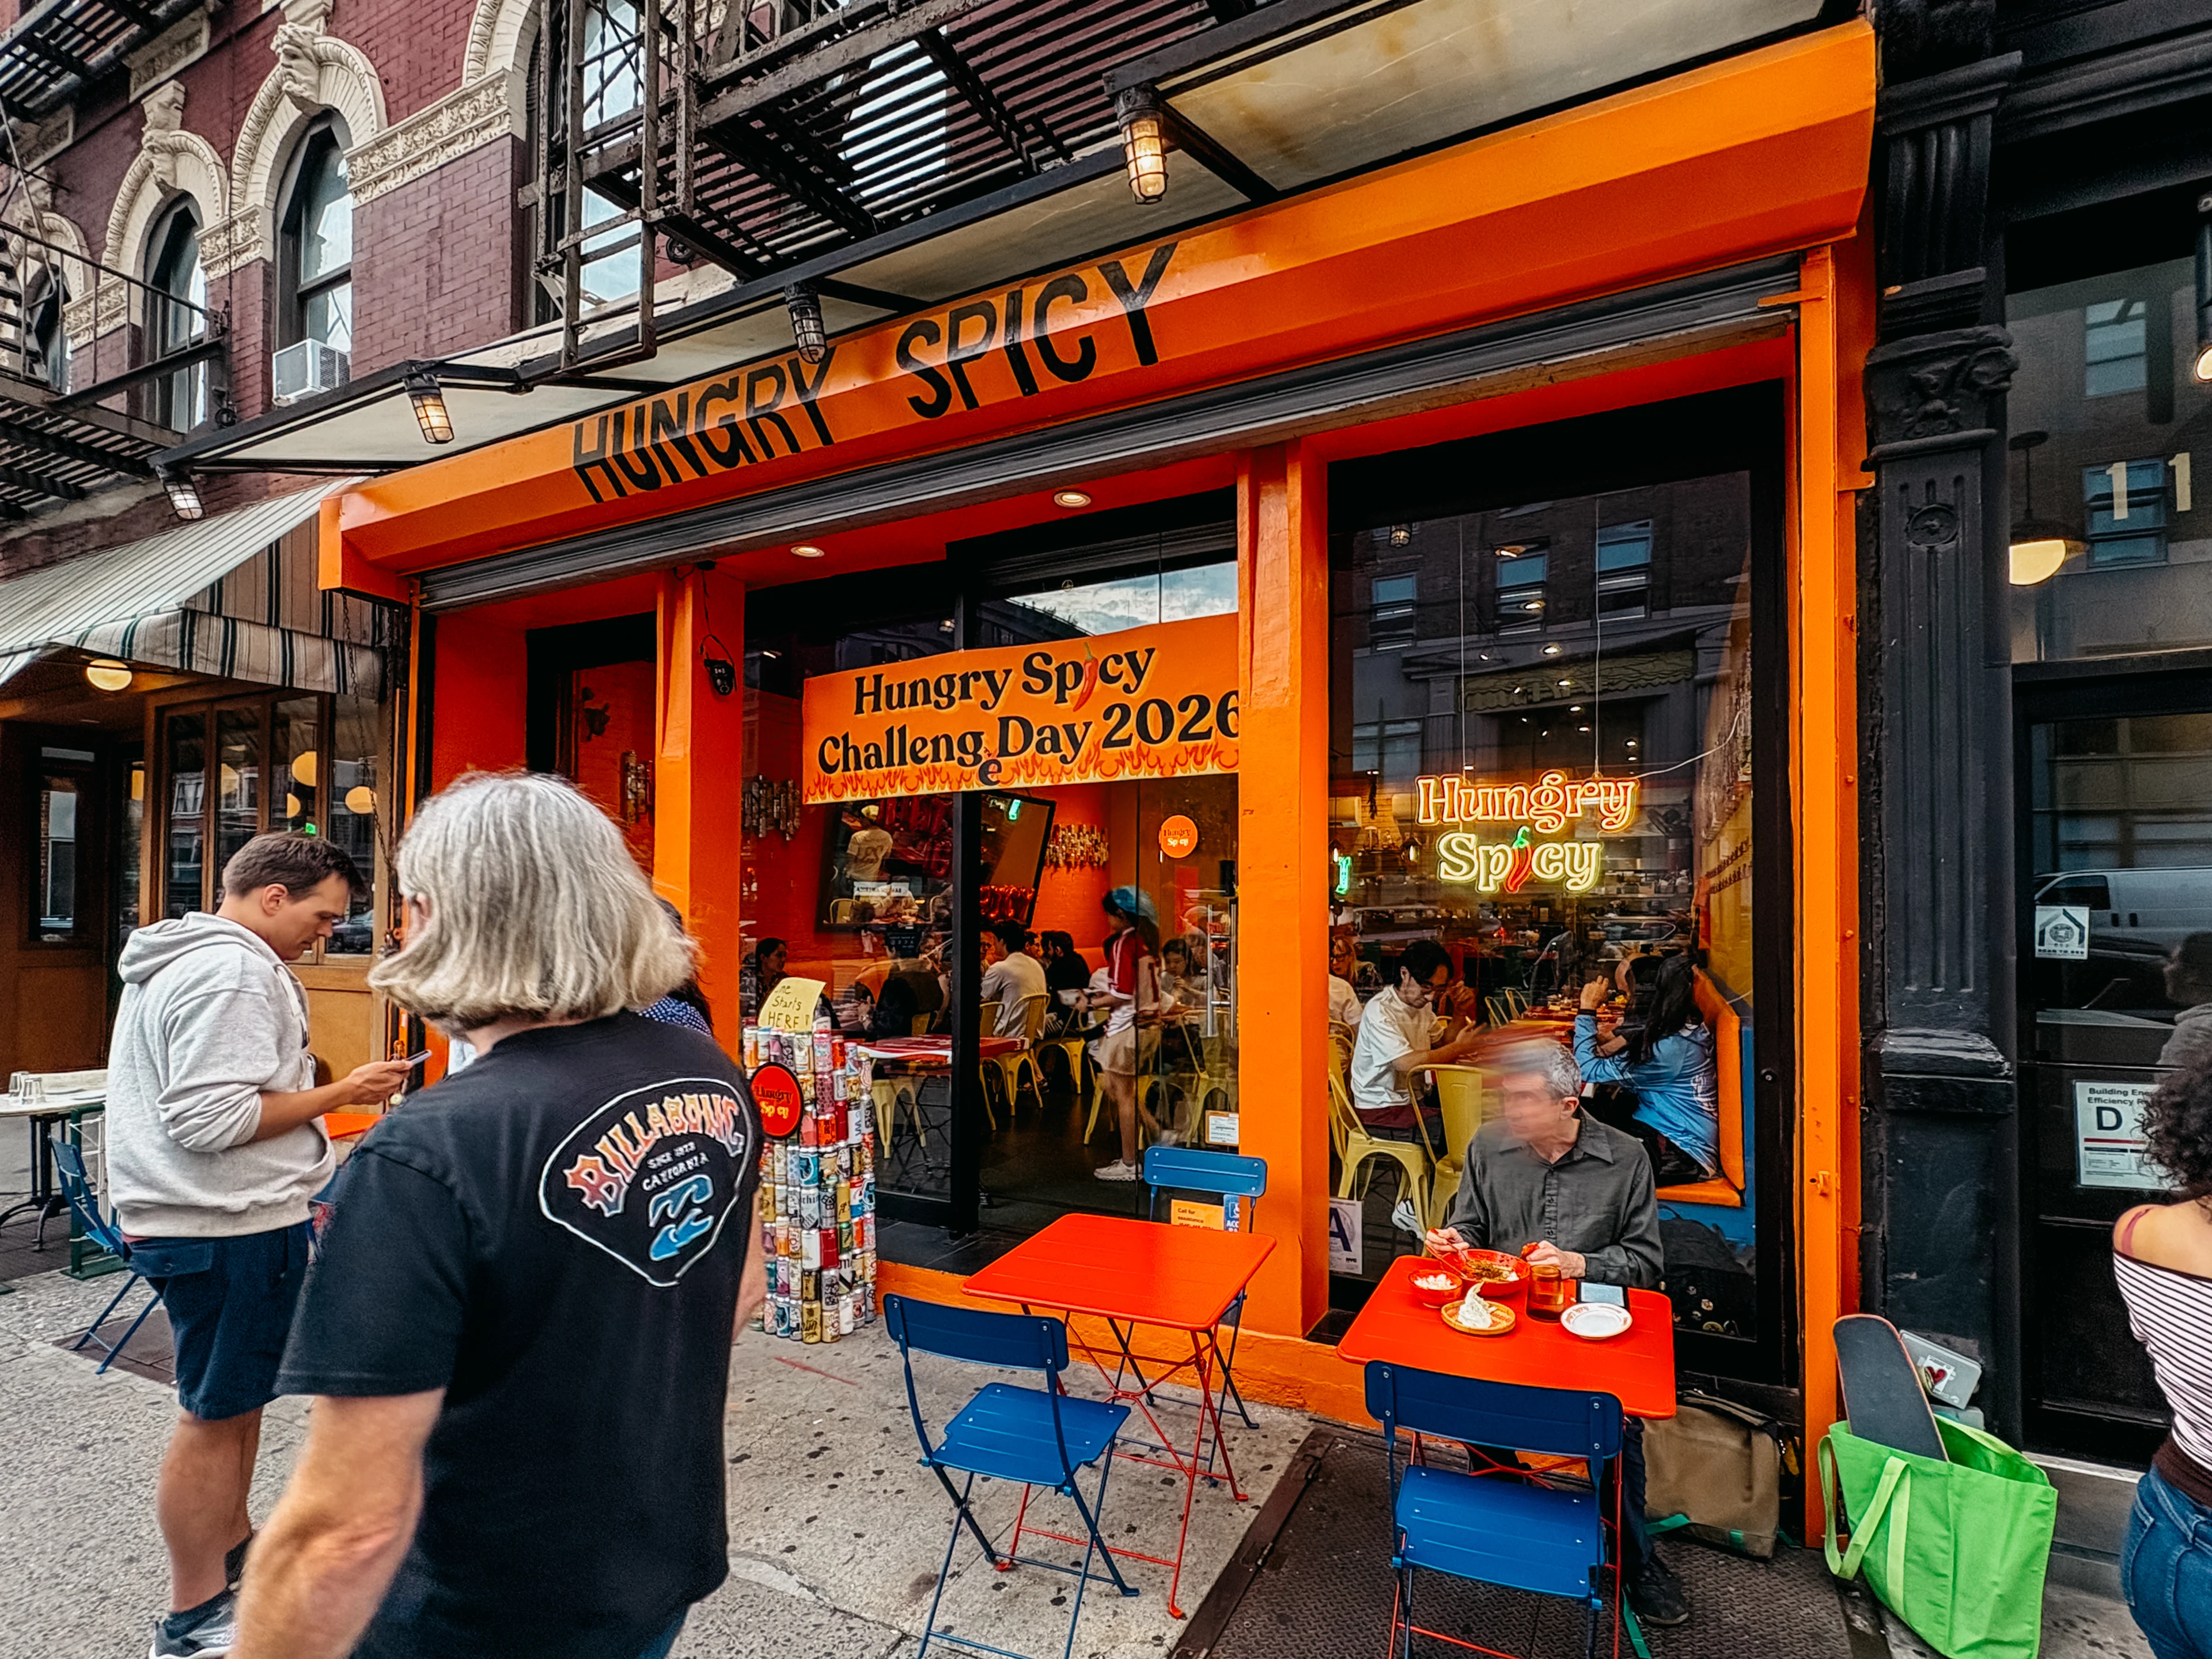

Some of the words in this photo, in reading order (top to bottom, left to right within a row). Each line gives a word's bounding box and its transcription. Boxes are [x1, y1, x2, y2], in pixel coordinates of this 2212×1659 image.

[573, 347, 835, 503] HUNGRY
[896, 241, 1179, 419] SPICY
[854, 669, 1013, 715] Hungry
[997, 716, 1093, 765] Day
[1102, 690, 1238, 749] 2026
[1415, 770, 1640, 834] Hungry
[1167, 838, 1188, 847] Spcy
[772, 995, 802, 1011] Starts
[2088, 1097, 2134, 1106] Efficiency
[2089, 1088, 2128, 1096] Building
[760, 1101, 789, 1119] Spcy
[2096, 1106, 2123, 1131] D
[562, 1094, 745, 1217] BILLABONG
[1329, 1207, 1353, 1252] A
